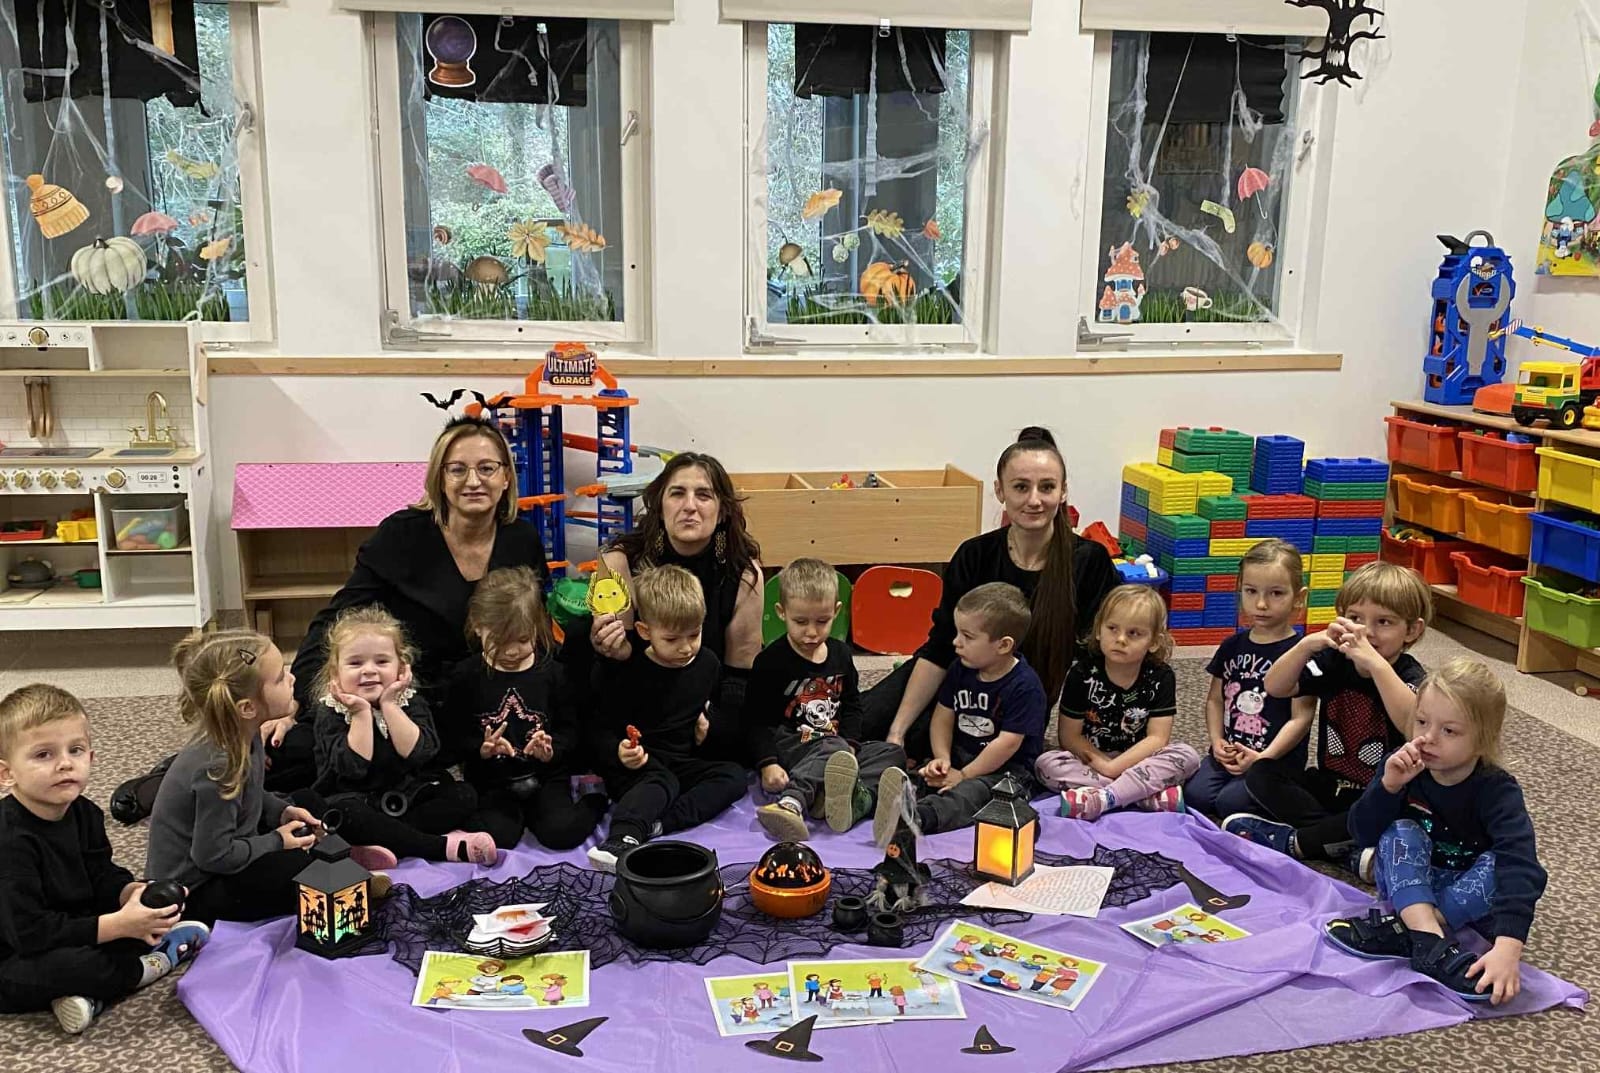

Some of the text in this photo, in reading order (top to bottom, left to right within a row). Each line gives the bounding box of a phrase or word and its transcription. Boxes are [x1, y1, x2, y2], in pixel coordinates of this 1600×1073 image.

[547, 356, 595, 373] ULTIMATE
[552, 376, 591, 385] GARAGE
[1223, 653, 1263, 680] HAPPY
